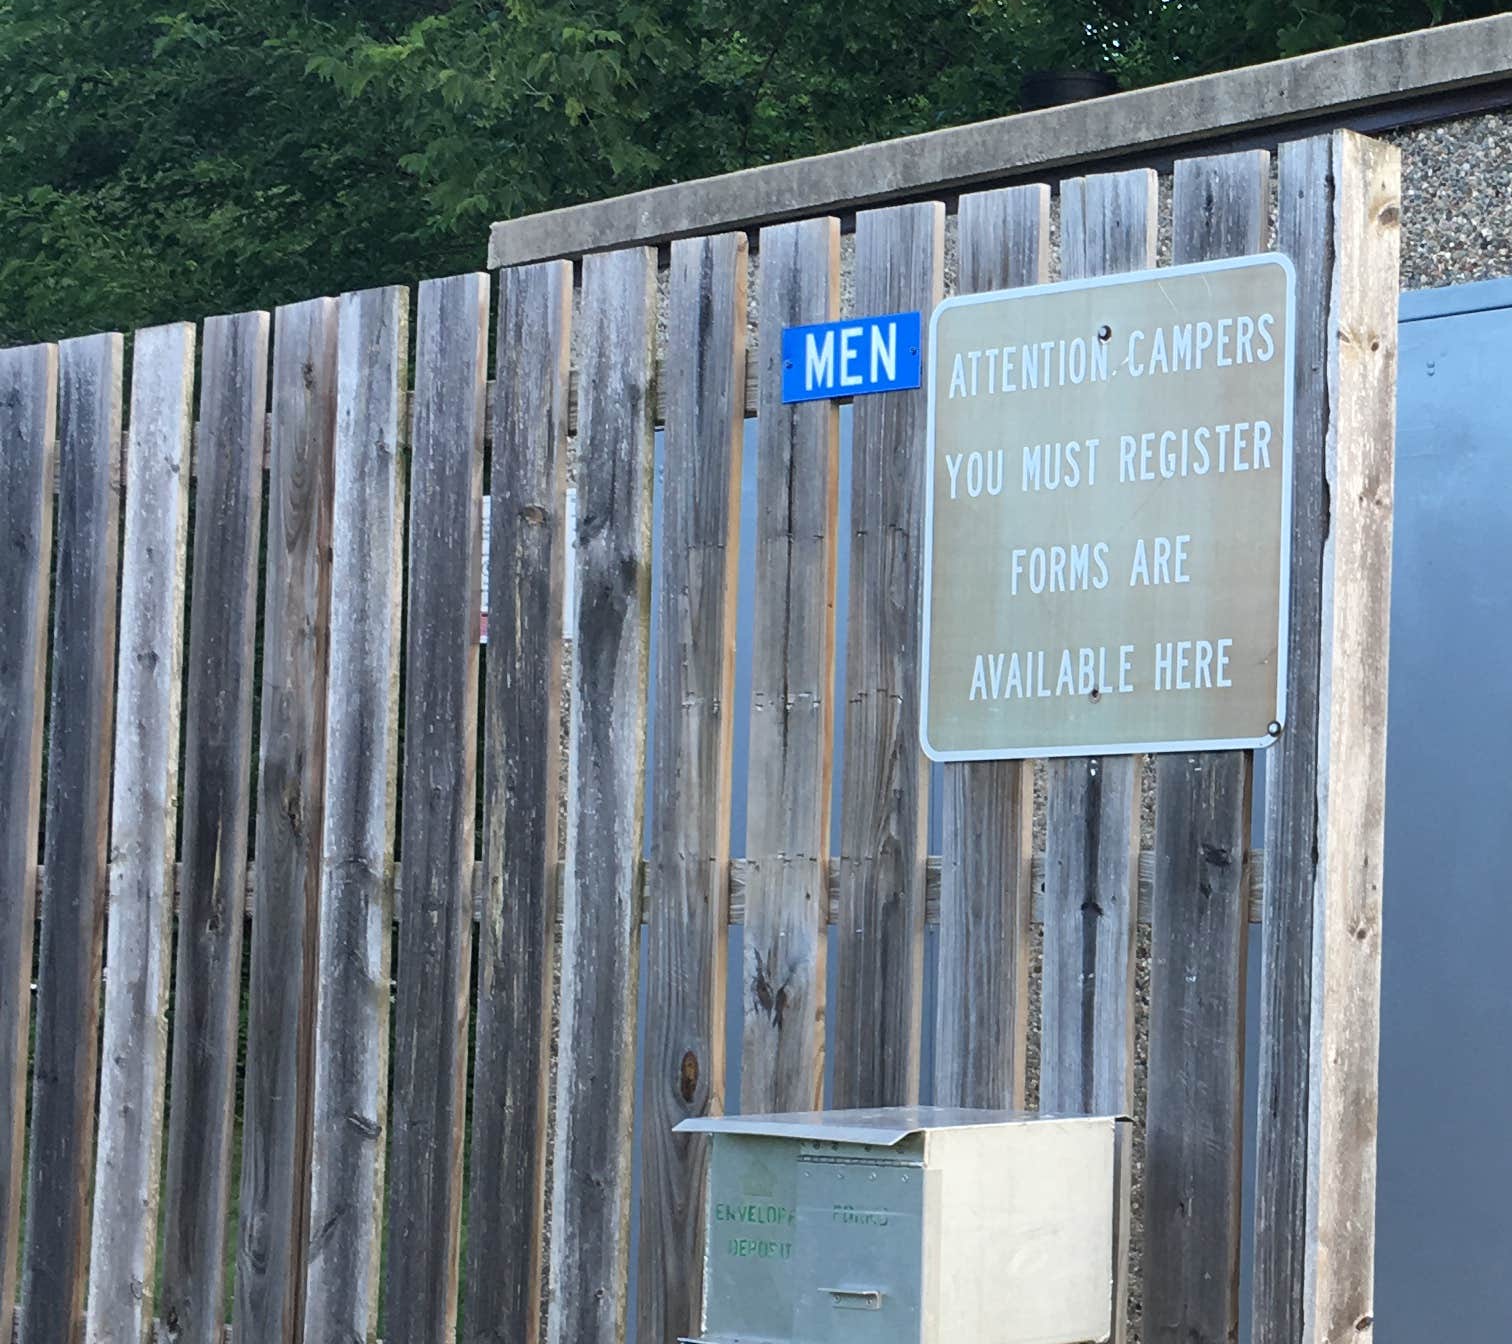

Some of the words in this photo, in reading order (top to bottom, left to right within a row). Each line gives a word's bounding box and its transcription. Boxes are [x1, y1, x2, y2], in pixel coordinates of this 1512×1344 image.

[805, 322, 897, 391] MEN
[949, 337, 1108, 399] ATTENTION
[1127, 313, 1275, 377] CAMPERS
[946, 449, 1003, 499] YOU
[1021, 439, 1099, 492] MUST
[1119, 420, 1272, 483] REGISTER
[1011, 542, 1109, 596] FORMS
[1129, 534, 1191, 586] ARE
[968, 644, 1135, 701] AVAILABLE
[1154, 638, 1233, 691] HERE
